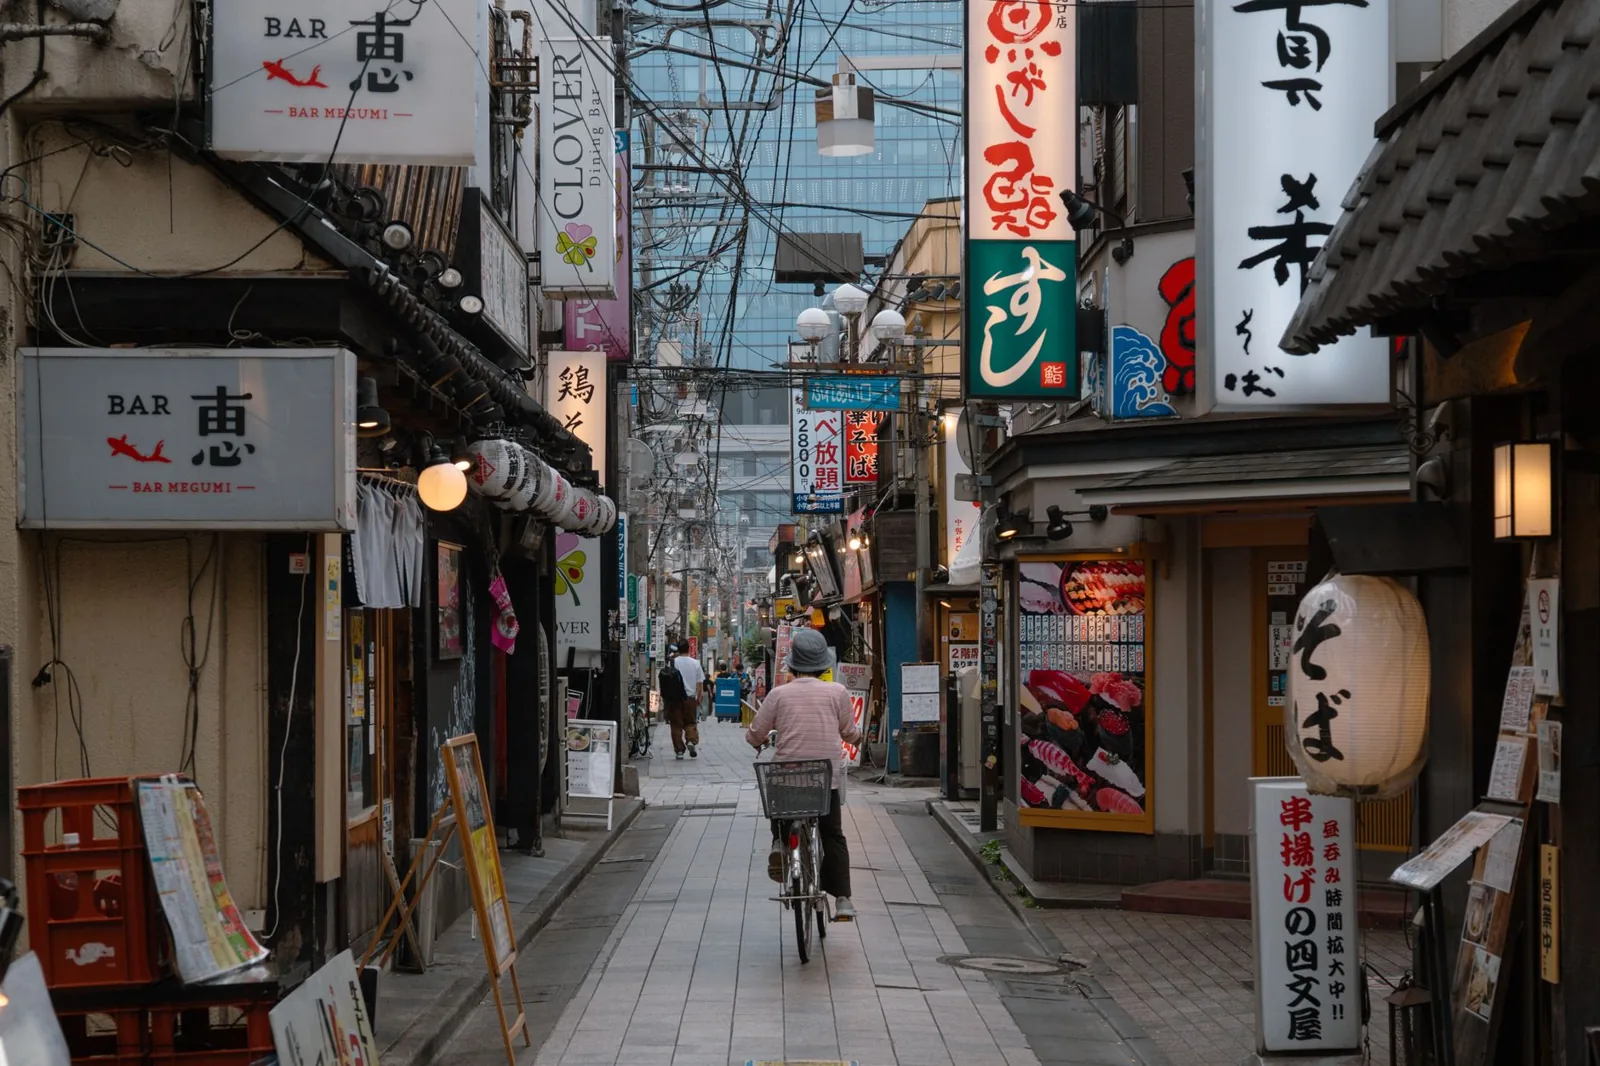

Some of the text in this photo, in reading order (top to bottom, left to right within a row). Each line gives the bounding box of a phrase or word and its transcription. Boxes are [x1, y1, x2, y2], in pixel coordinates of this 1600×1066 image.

[264, 17, 328, 39] BAR
[348, 12, 414, 93] 恵
[1055, 0, 1068, 29] 口店
[288, 107, 388, 119] BAR MEGUMI
[552, 51, 584, 220] CLOVER
[589, 89, 604, 187] Dining Bar
[980, 246, 1067, 387] すし
[1224, 308, 1286, 399] そば
[107, 395, 171, 415] BAR
[811, 382, 896, 404] ふれあいロード
[1044, 365, 1064, 385] 鮨
[191, 386, 256, 467] 恵
[815, 410, 839, 491] べ放題
[132, 482, 231, 493] BAR MEGUMI
[556, 621, 590, 635] VER
[1293, 599, 1352, 764] そば
[1280, 795, 1322, 1041] 串揚げの四文屋
